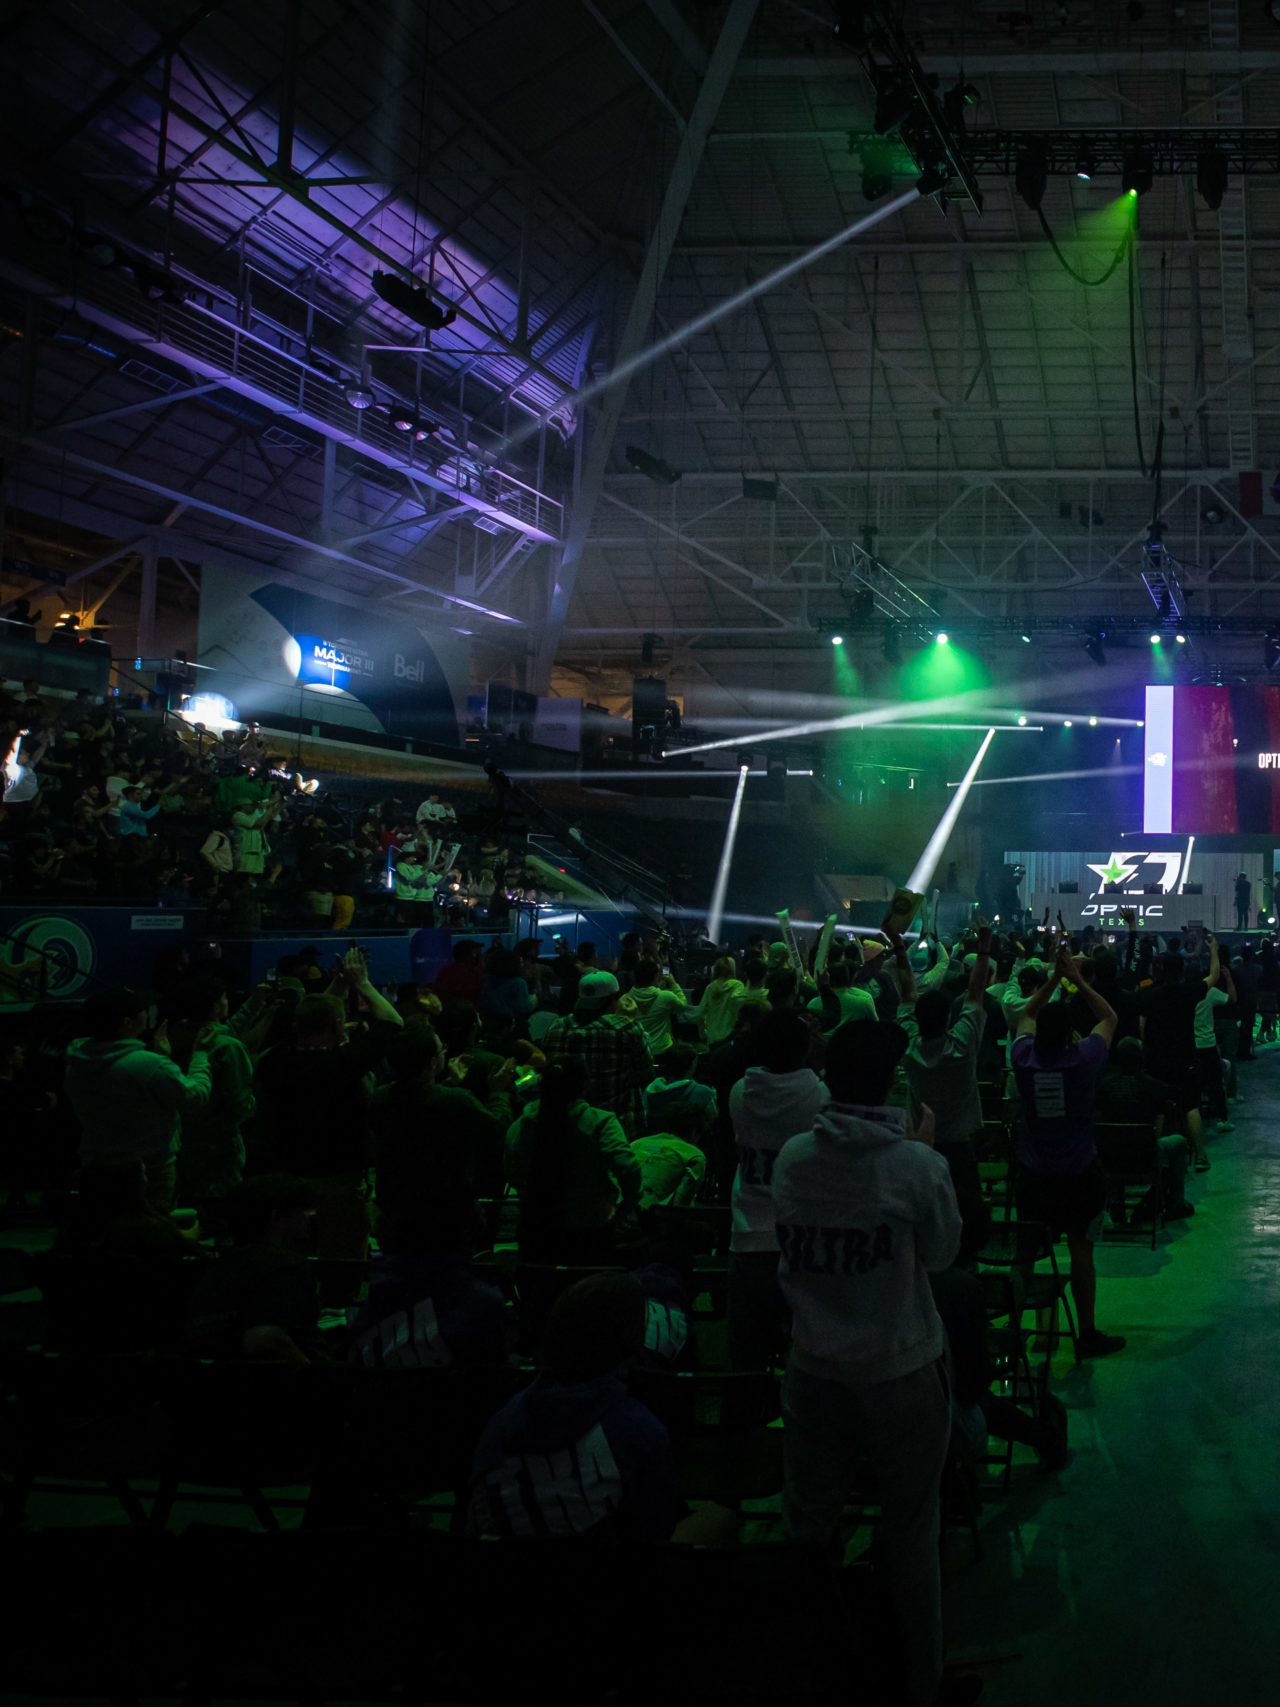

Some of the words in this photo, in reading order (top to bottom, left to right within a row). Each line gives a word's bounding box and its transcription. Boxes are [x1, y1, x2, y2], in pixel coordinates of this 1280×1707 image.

[314, 645, 361, 668] MAJOR
[394, 653, 425, 683] Bell
[1099, 918, 1145, 926] TEXS
